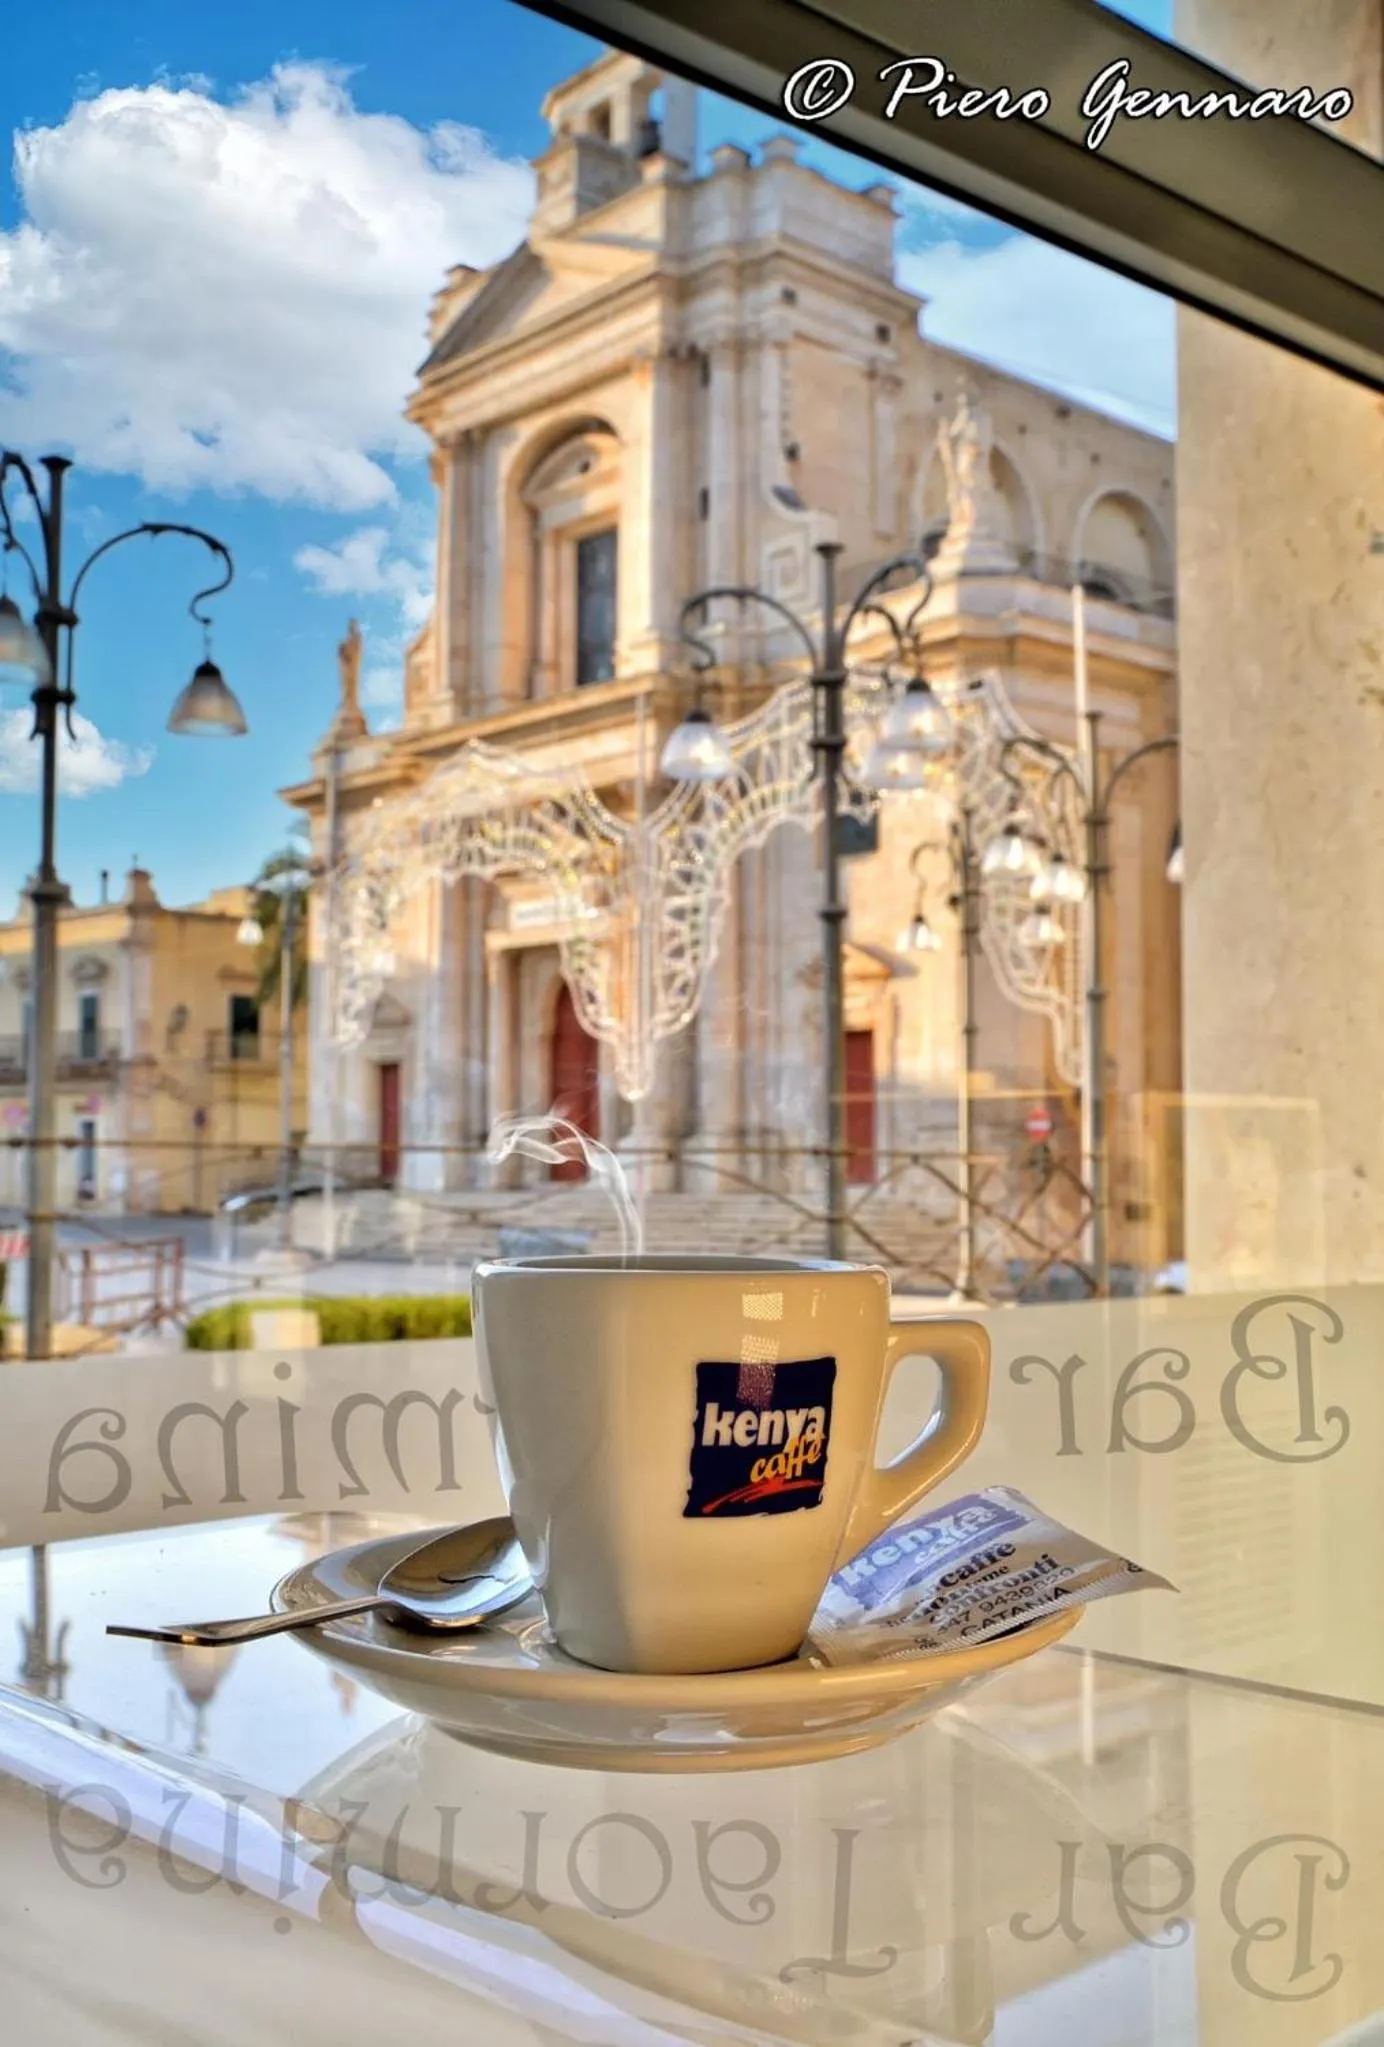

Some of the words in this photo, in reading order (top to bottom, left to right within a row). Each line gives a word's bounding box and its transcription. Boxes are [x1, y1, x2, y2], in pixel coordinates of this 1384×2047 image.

[702, 1402, 826, 1454] kenya
[42, 1783, 898, 1985] Taormina
[1008, 1833, 1351, 2003] Bar
